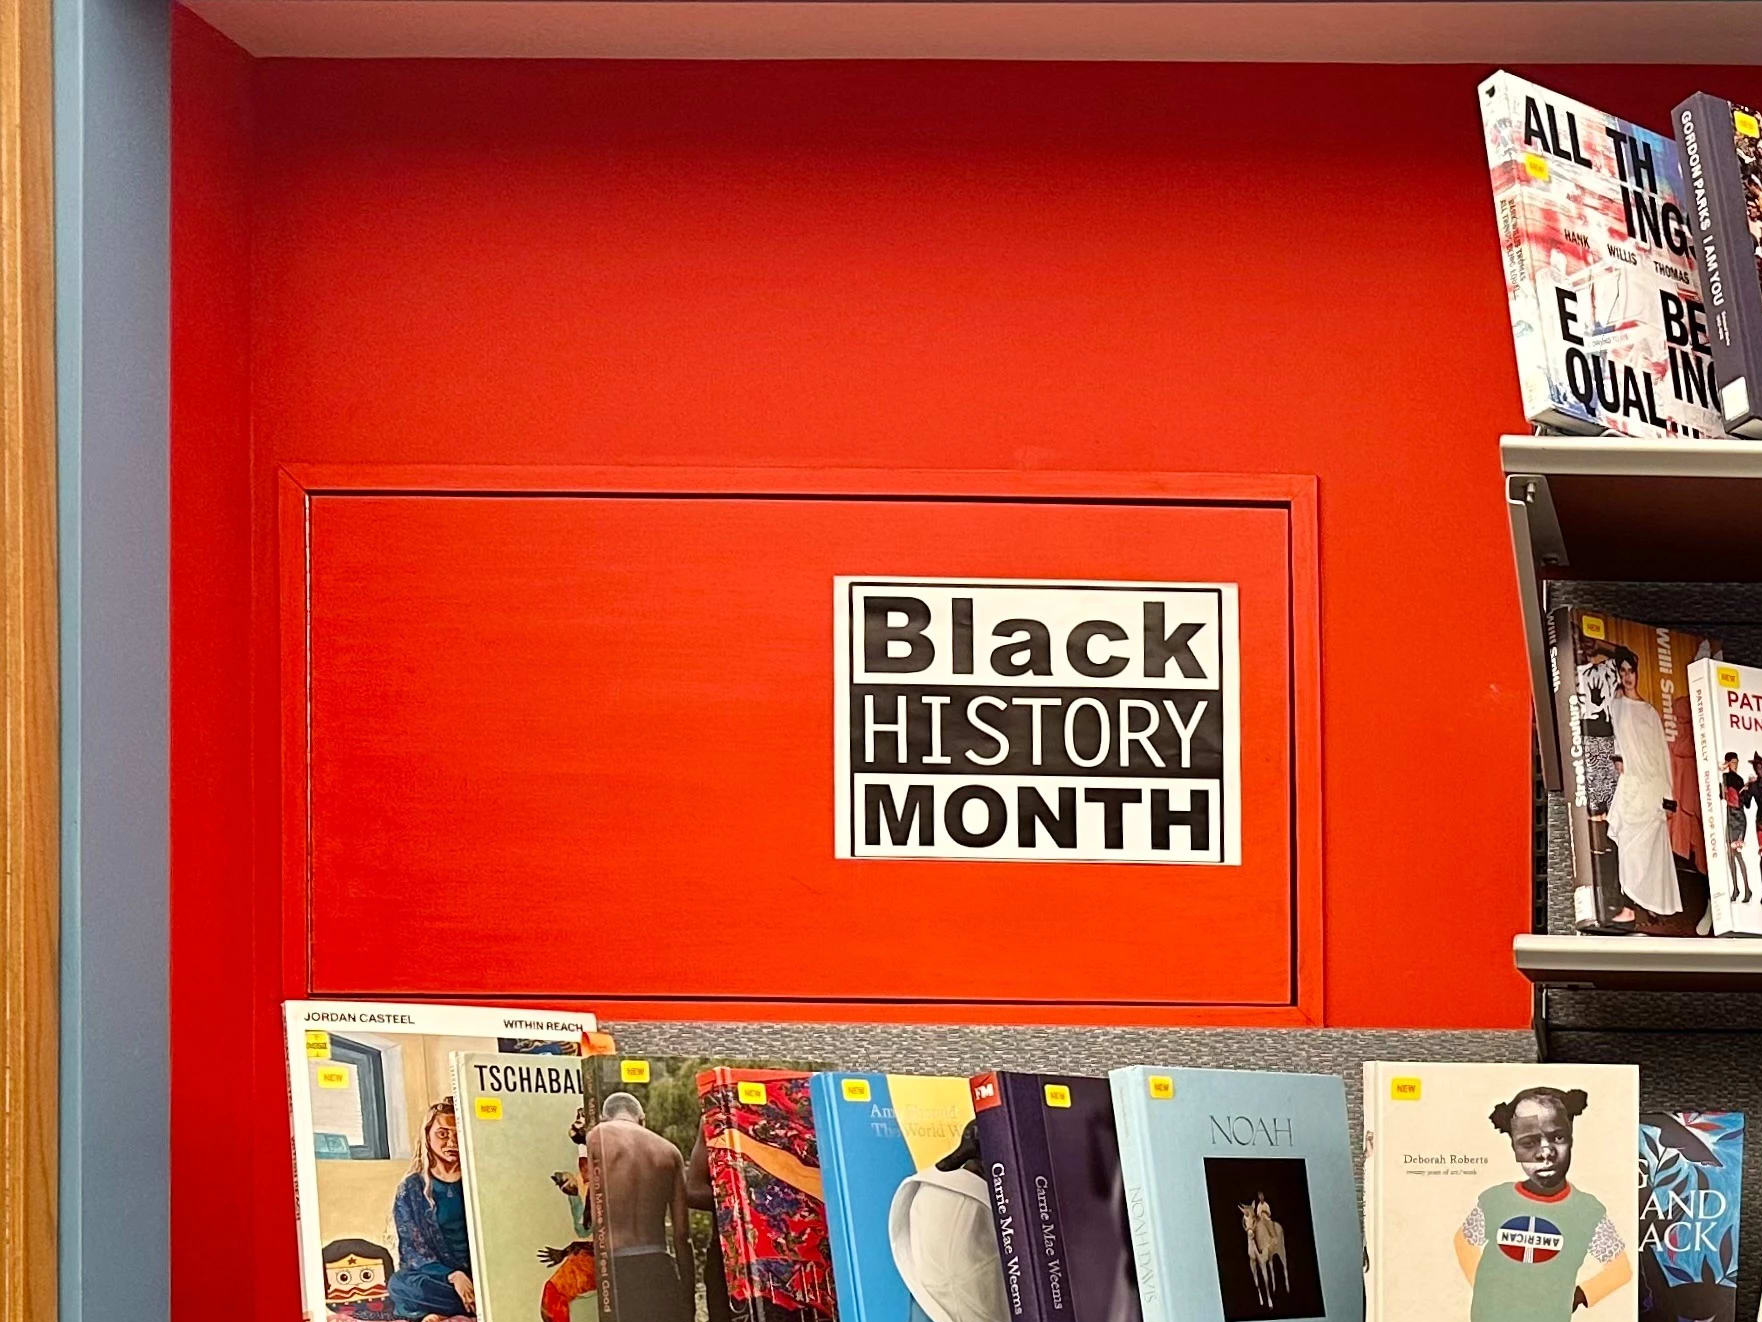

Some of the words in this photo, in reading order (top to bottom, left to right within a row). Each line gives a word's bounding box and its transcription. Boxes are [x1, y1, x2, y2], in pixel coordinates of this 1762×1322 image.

[1524, 95, 1592, 169] ALL
[1606, 127, 1657, 194] TH
[1680, 110, 1701, 179] GORDON
[1693, 177, 1712, 231] PARKS
[1564, 229, 1590, 248] HANK
[1607, 244, 1638, 266] WILLIS
[1654, 261, 1690, 285] THOMAS
[1704, 245, 1720, 268] AM
[1707, 268, 1725, 306] YOU
[1555, 287, 1584, 346] E
[1660, 289, 1712, 356] BE
[863, 595, 1209, 680] Black
[1656, 627, 1673, 674] Willi
[864, 694, 1209, 769] HISTORY
[1569, 694, 1583, 758] Couture
[1660, 679, 1679, 743] Smith
[864, 783, 1211, 851] MONTH
[304, 1011, 356, 1025] JORDAN
[359, 1013, 415, 1025] CASTEEL
[504, 1019, 545, 1031] WITHIN
[1209, 1115, 1293, 1146] NOAH
[1403, 1153, 1446, 1165] Deborah
[1449, 1154, 1489, 1165] Roberts
[1035, 1175, 1051, 1221] Carrie
[1640, 1189, 1727, 1220] AND
[991, 1163, 1007, 1215] Carrie
[1000, 1217, 1013, 1254] Mae
[1008, 1256, 1022, 1315] Weems
[1042, 1224, 1056, 1256] Mae
[1500, 1231, 1561, 1248] AMERICAN
[1048, 1256, 1063, 1310] Weems
